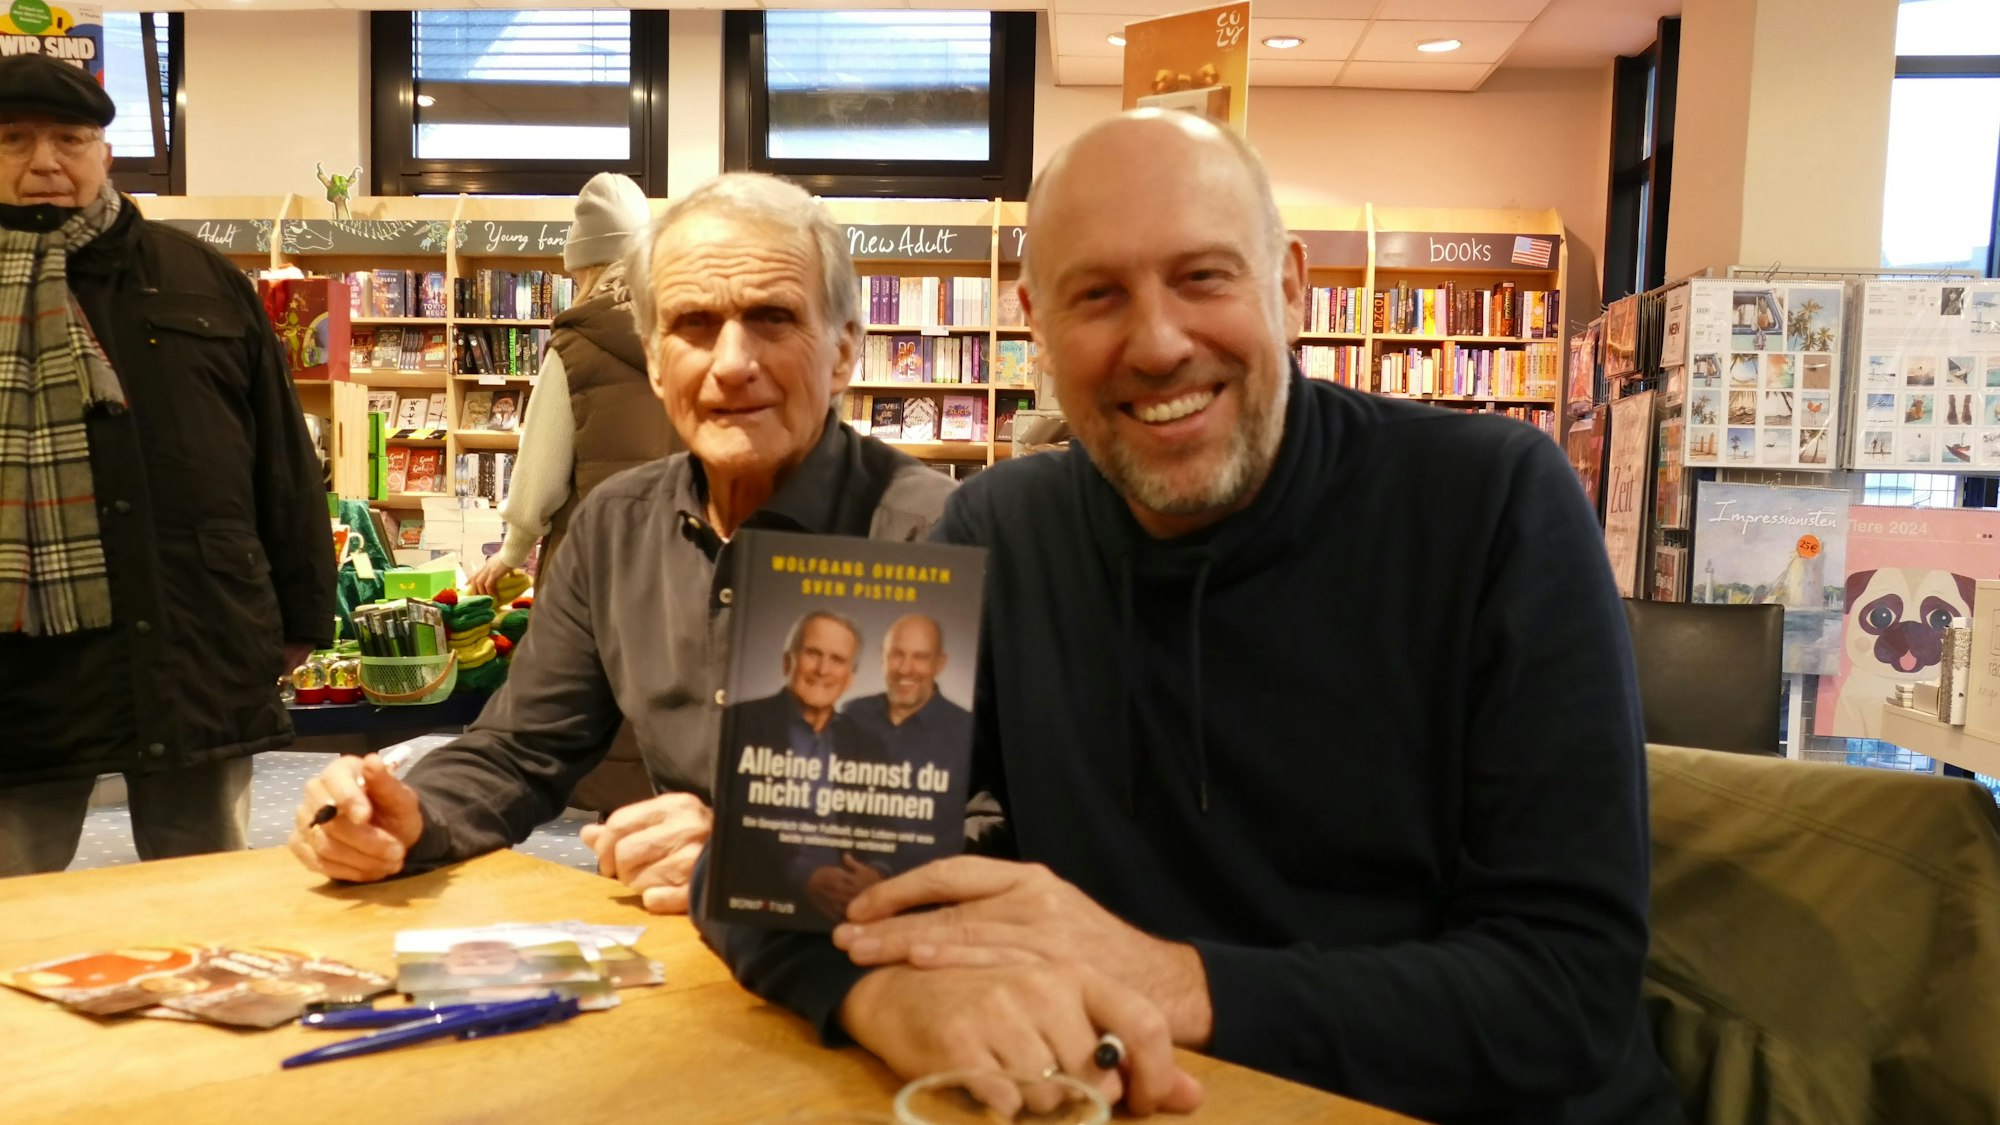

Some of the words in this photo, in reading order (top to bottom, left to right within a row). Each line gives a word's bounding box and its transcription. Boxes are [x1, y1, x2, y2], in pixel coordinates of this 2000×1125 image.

[0, 36, 40, 57] WIR
[44, 37, 95, 60] SIND
[197, 221, 242, 248] Adult
[484, 221, 529, 252] Young
[847, 226, 894, 255] New
[897, 226, 958, 257] Adult
[1430, 236, 1491, 263] books
[1610, 464, 1635, 514] Zeit
[1709, 500, 1836, 535] Impressionisten
[1888, 521, 1929, 535] 2024
[1799, 540, 1818, 554] 25€
[771, 555, 864, 577] WOLFGANG
[872, 562, 951, 584] OVERATH
[801, 578, 846, 597] SVEN
[853, 582, 917, 602] PISTOR
[737, 745, 822, 781] Alleine
[828, 752, 912, 789] kannst
[917, 762, 950, 793] du
[748, 778, 811, 809] nicht
[815, 787, 935, 820] gewinnen
